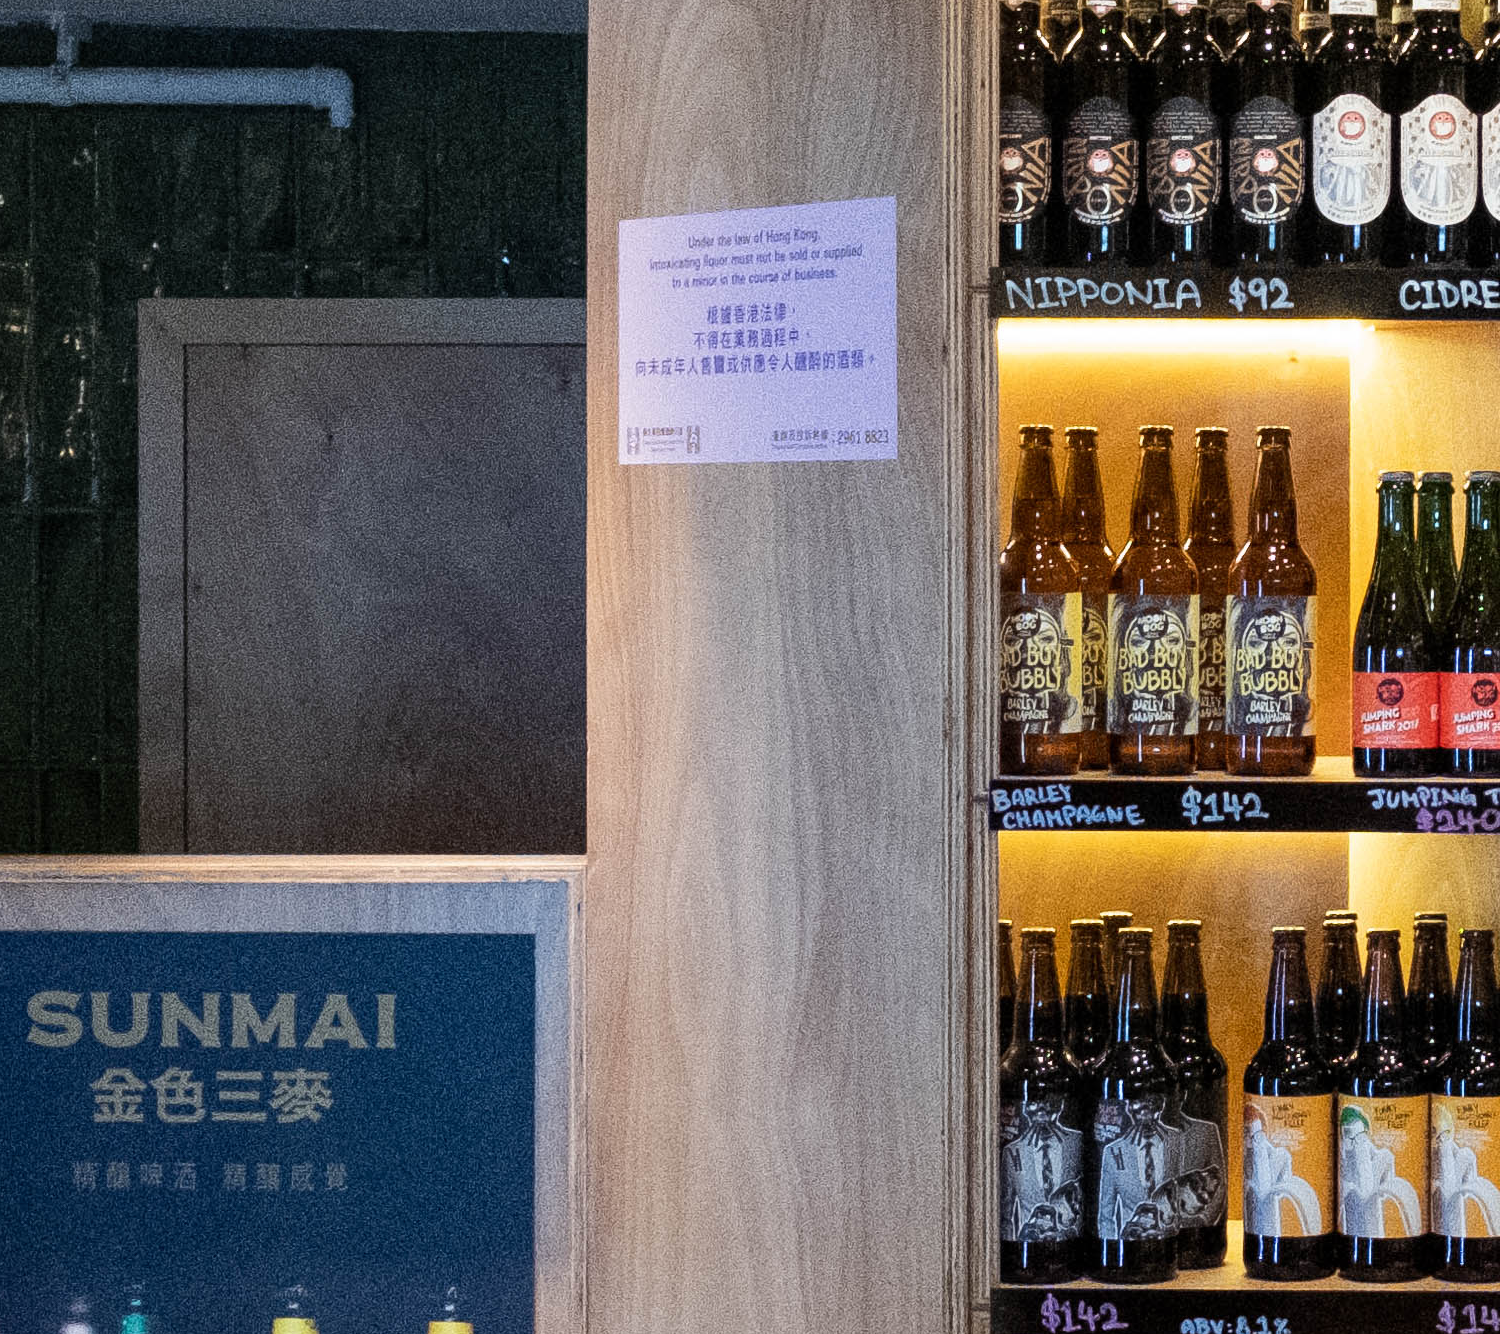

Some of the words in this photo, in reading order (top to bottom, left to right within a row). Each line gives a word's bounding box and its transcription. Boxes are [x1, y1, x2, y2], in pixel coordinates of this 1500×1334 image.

[688, 236, 714, 249] Under
[718, 235, 732, 246] the
[754, 233, 763, 244] of
[766, 232, 790, 244] Hong
[731, 254, 752, 265] must
[756, 253, 771, 263] not
[774, 251, 786, 262] be
[789, 250, 808, 261] sold
[824, 244, 862, 259] supplied
[692, 276, 717, 287] minor
[732, 274, 746, 284] the
[749, 272, 778, 283] course
[782, 271, 791, 281] of
[795, 268, 837, 281] business.
[1006, 278, 1202, 309] NIPPONIA
[1228, 277, 1294, 311] $92
[1118, 649, 1149, 670] BAD
[1156, 648, 1186, 669] BOY
[1236, 649, 1267, 670] BAD
[1273, 648, 1303, 669] BOY
[1122, 669, 1186, 694] BUBBLY
[1240, 669, 1303, 695] BUBBLY
[1361, 708, 1399, 722] JUMPING
[1454, 708, 1495, 722] JUMPING
[1364, 721, 1395, 734] SHARK
[1456, 722, 1489, 735] SHARK
[992, 785, 1072, 811] BARLEY
[1181, 789, 1270, 823] $142
[1368, 787, 1476, 811] JUMPING
[1002, 805, 1145, 829] CHAMPAGNE
[1416, 808, 1500, 835] $240
[26, 992, 398, 1049] SUNMAI
[89, 1067, 333, 1123] 金色三麥
[1041, 1294, 1129, 1333] $142
